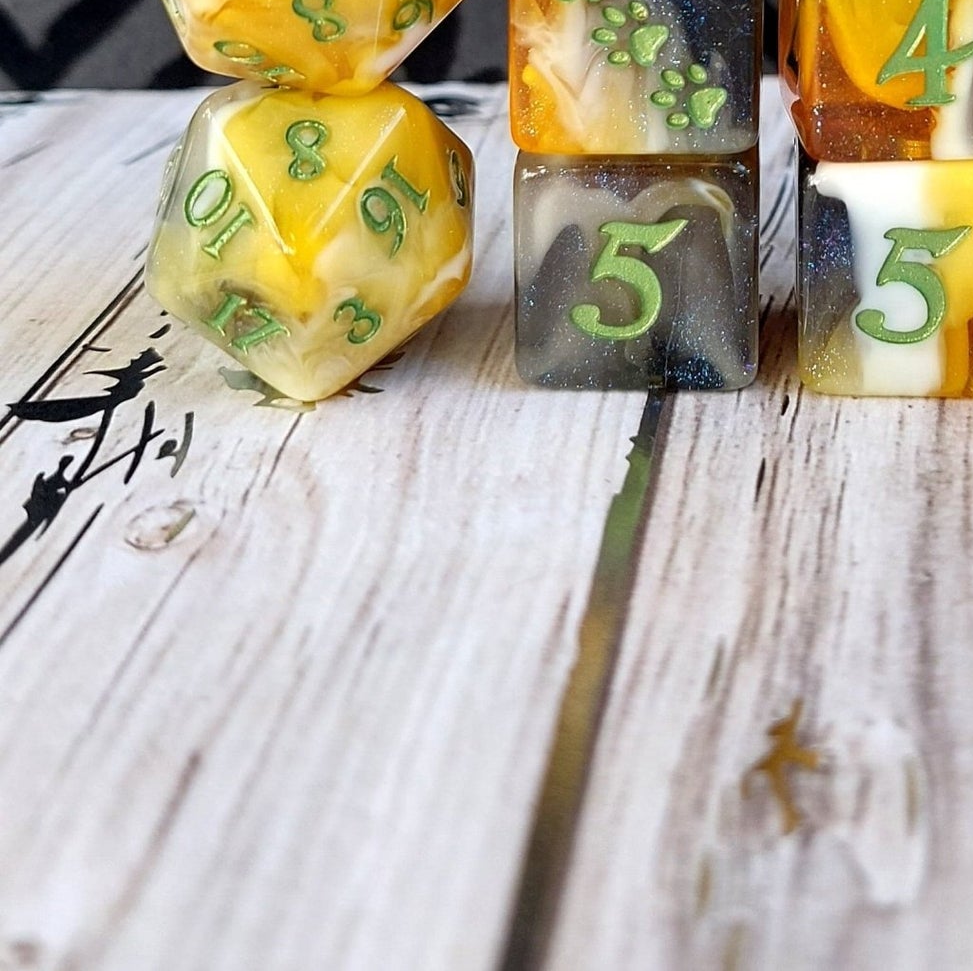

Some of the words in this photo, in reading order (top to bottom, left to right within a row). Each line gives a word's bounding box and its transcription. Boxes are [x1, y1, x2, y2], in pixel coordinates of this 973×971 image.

[284, 118, 330, 181] 8
[182, 168, 257, 261] 10
[332, 297, 384, 346] 3
[568, 218, 690, 341] 5
[855, 224, 973, 345] 5
